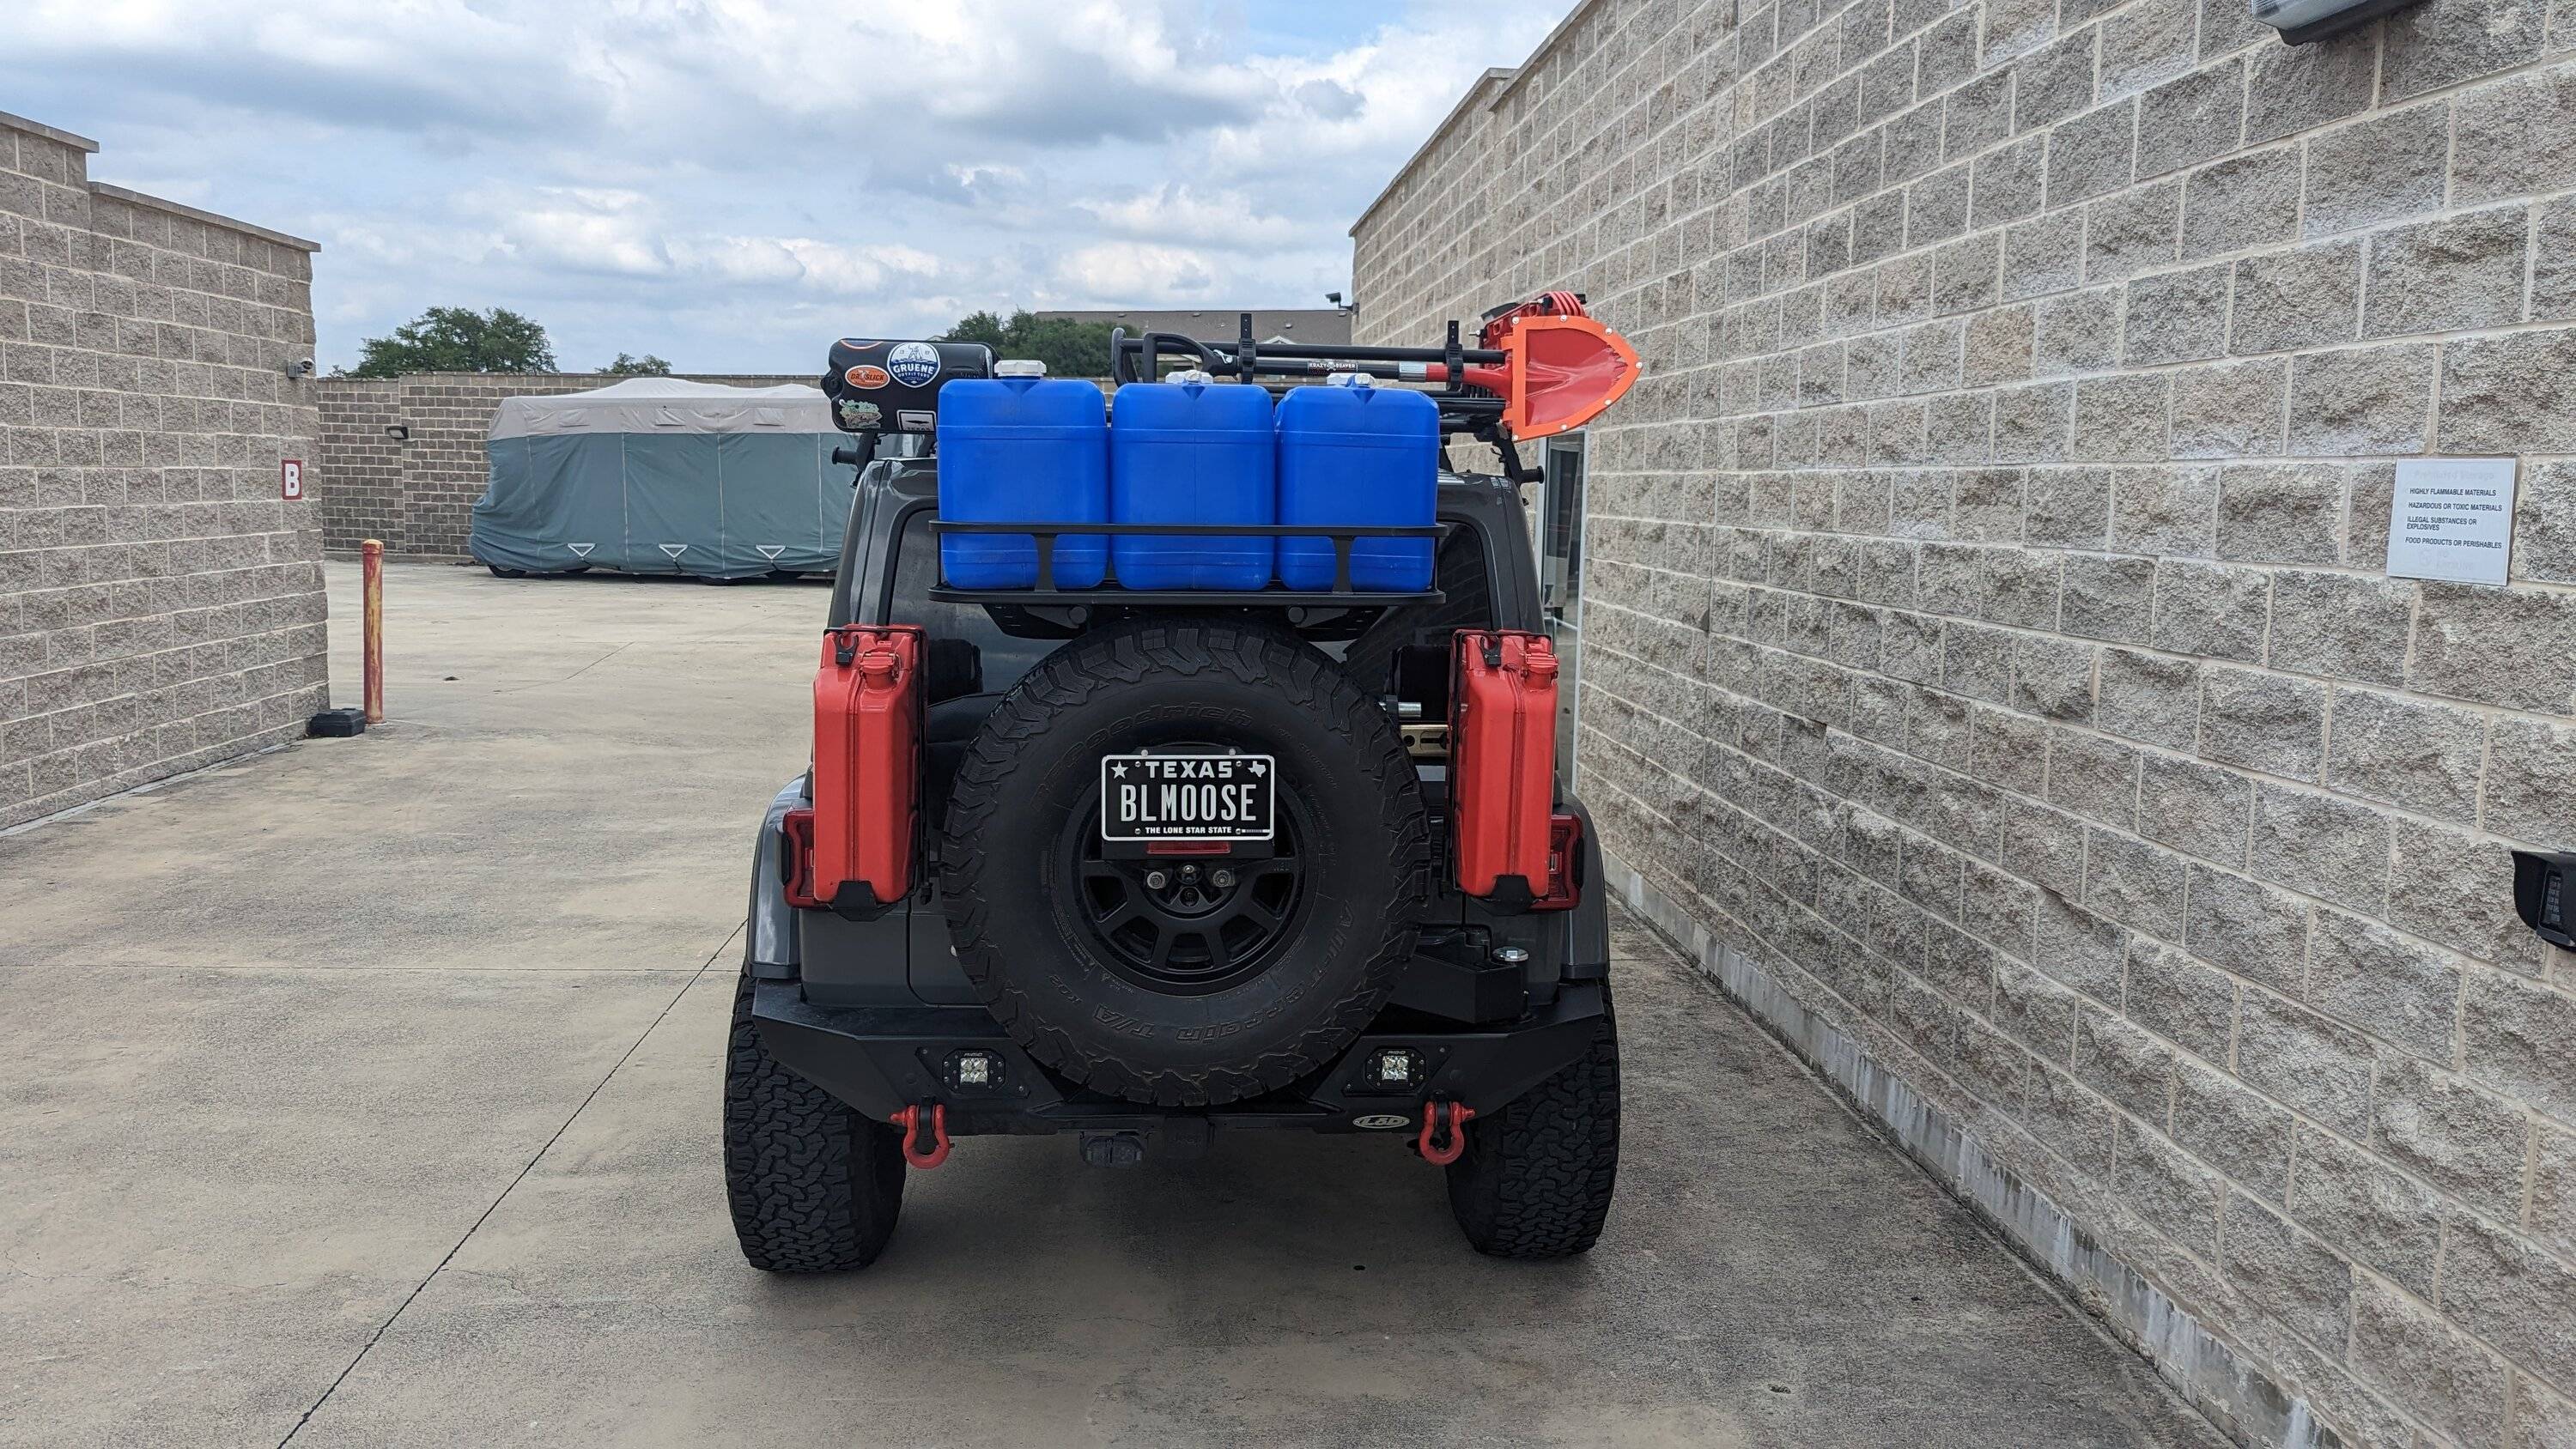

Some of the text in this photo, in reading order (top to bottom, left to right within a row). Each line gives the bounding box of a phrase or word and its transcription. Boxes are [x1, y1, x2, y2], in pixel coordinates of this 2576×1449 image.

[893, 363, 935, 374] GRUENE
[285, 464, 300, 496] B
[2421, 537, 2451, 546] PRODUCTS
[2463, 540, 2502, 549] PERISHABLES
[1145, 761, 1232, 779] TEXAS
[1121, 784, 1257, 822] BLMOOSE
